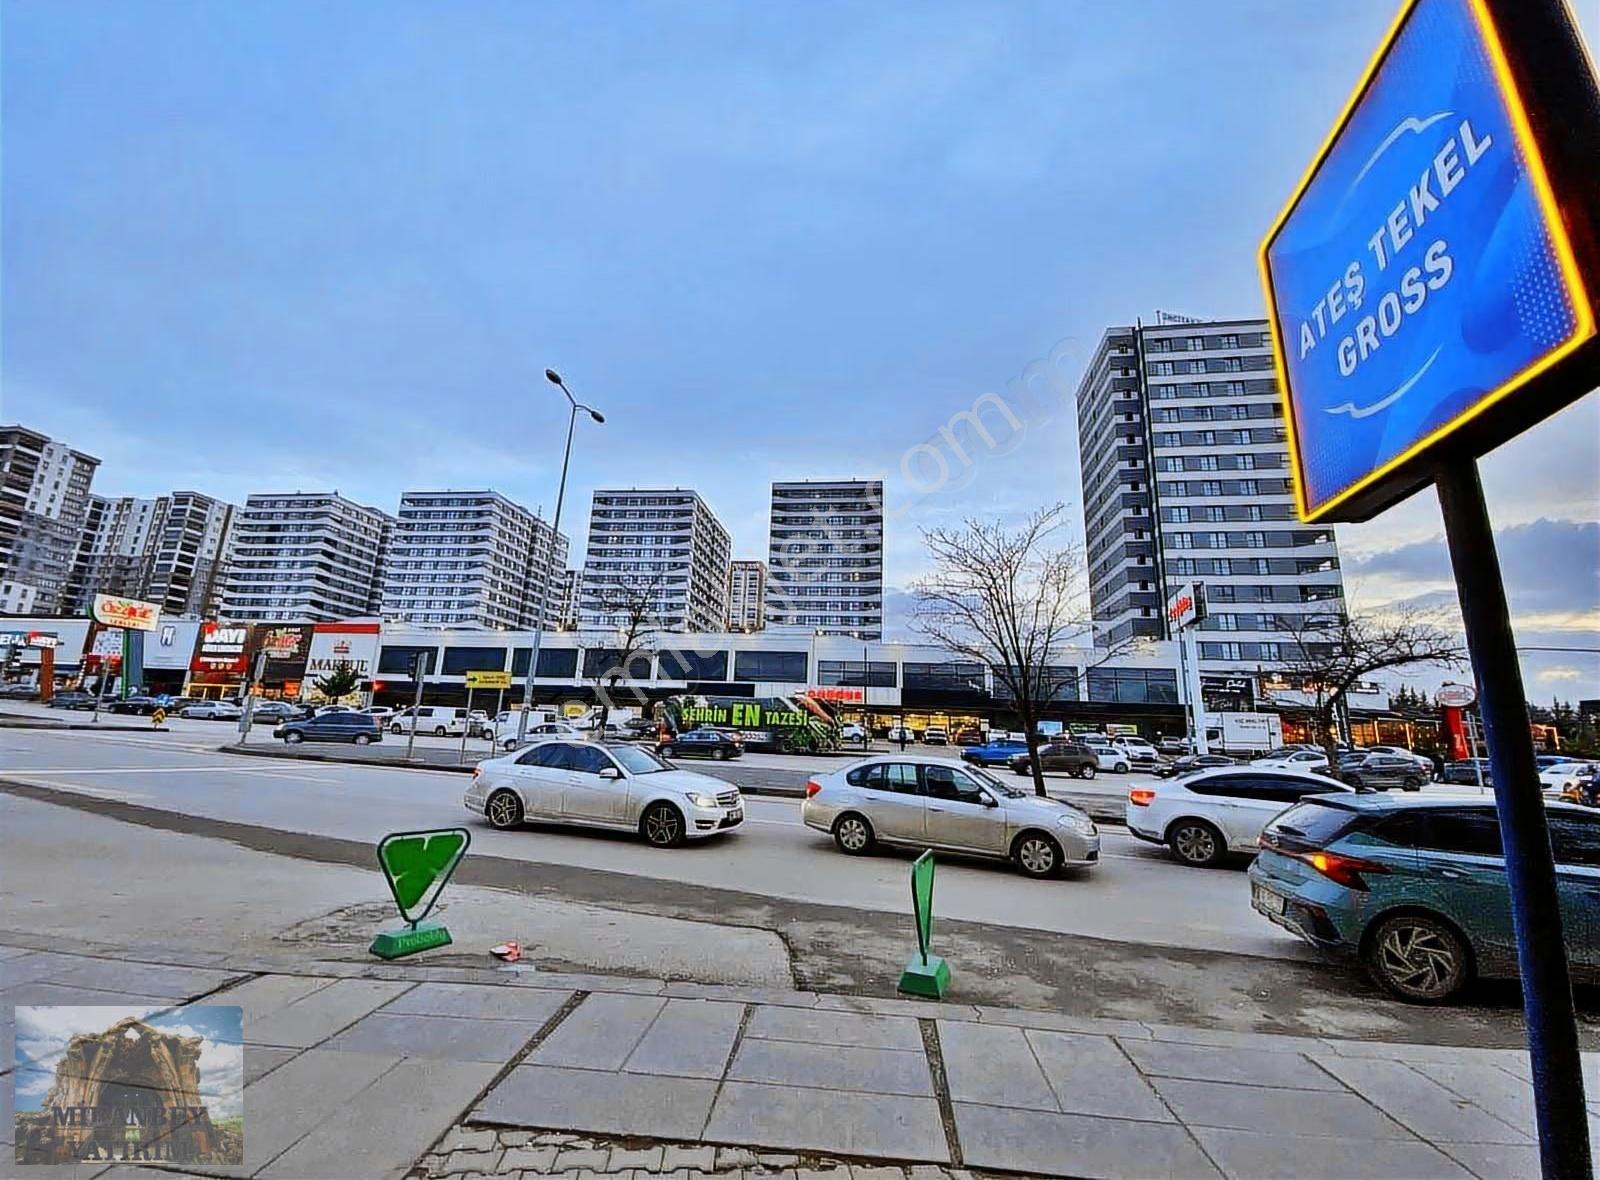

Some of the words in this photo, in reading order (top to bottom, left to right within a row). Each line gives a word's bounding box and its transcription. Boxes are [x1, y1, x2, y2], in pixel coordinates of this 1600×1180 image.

[1299, 261, 1366, 360] ATEŞ
[1367, 119, 1494, 271] TEKEL
[1336, 238, 1455, 378] GROSS
[731, 703, 761, 727] EN
[765, 709, 808, 727] TAZESİ
